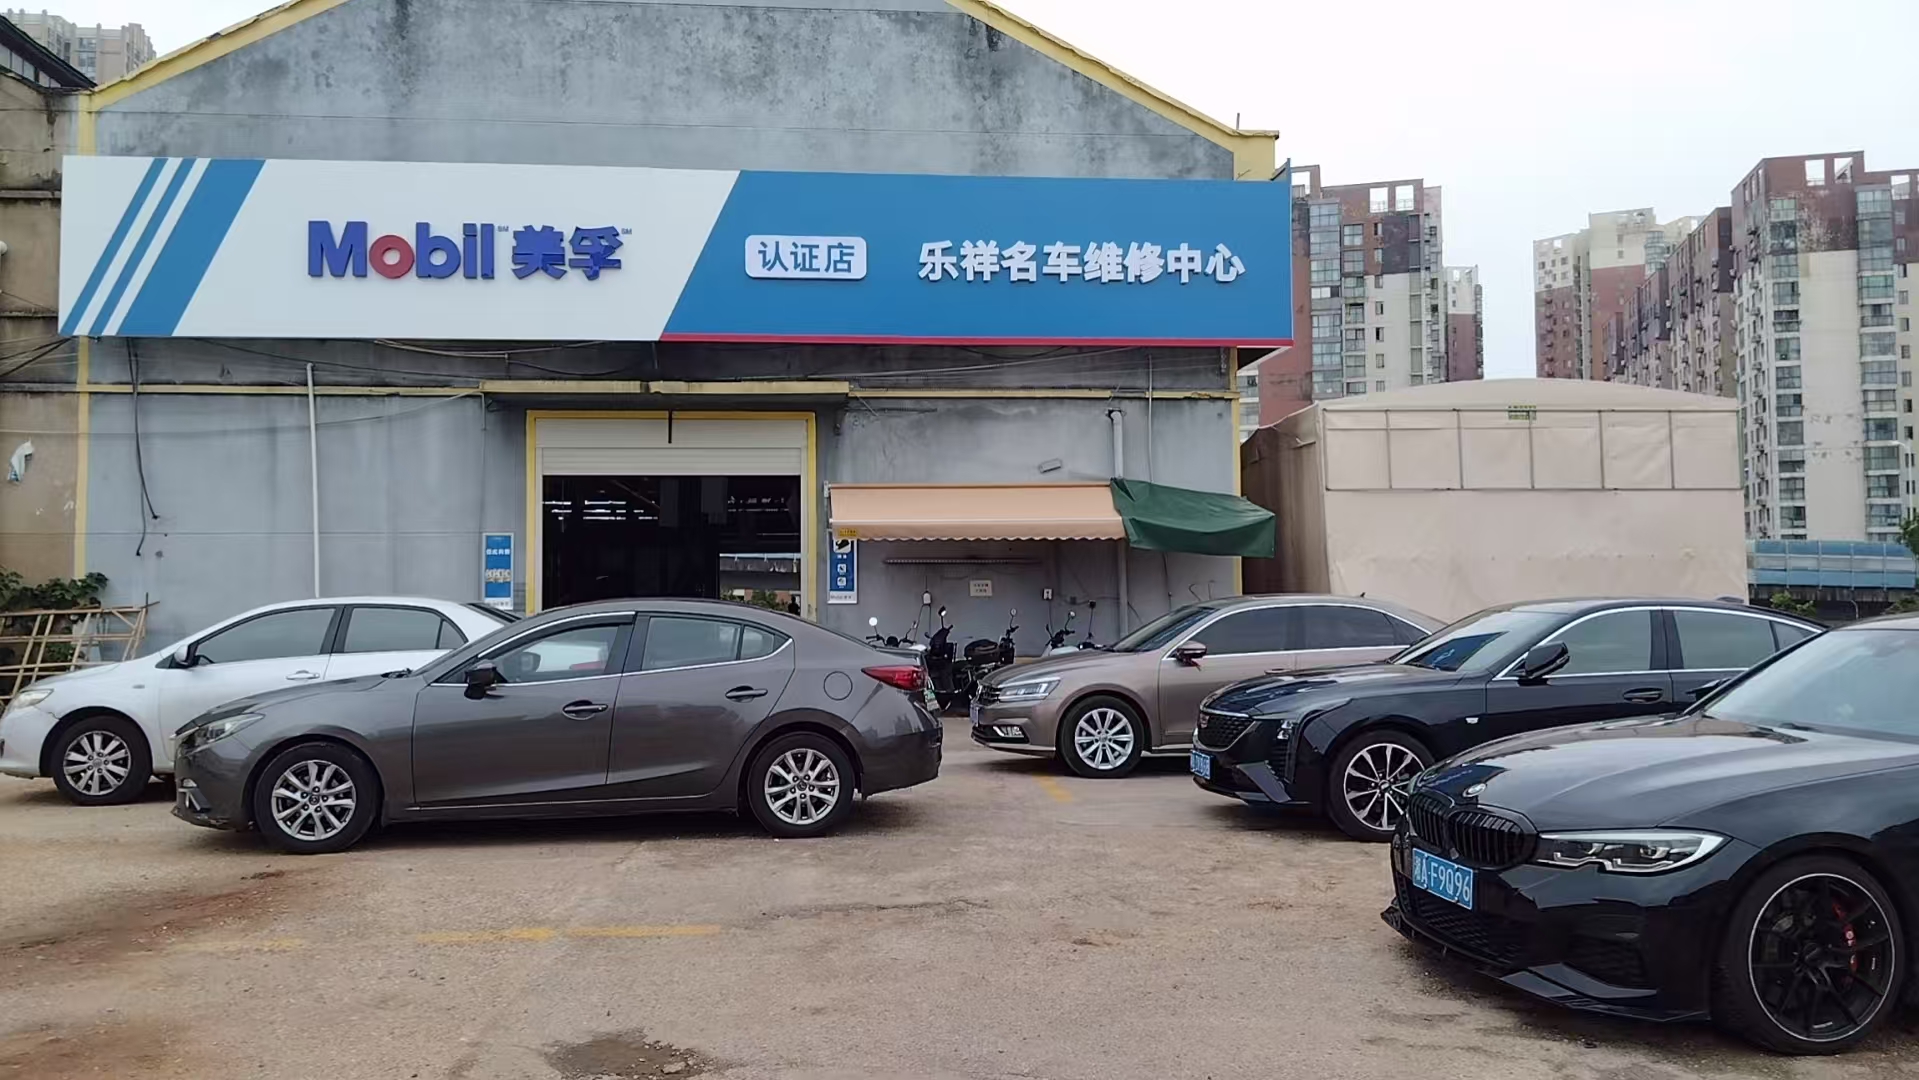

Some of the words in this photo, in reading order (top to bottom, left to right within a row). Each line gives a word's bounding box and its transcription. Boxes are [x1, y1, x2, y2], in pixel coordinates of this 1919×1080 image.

[308, 220, 495, 279] Mobil
[511, 224, 624, 281] 美孚
[757, 240, 856, 274] 认证店
[918, 240, 1246, 284] 乐祥名车维修中心
